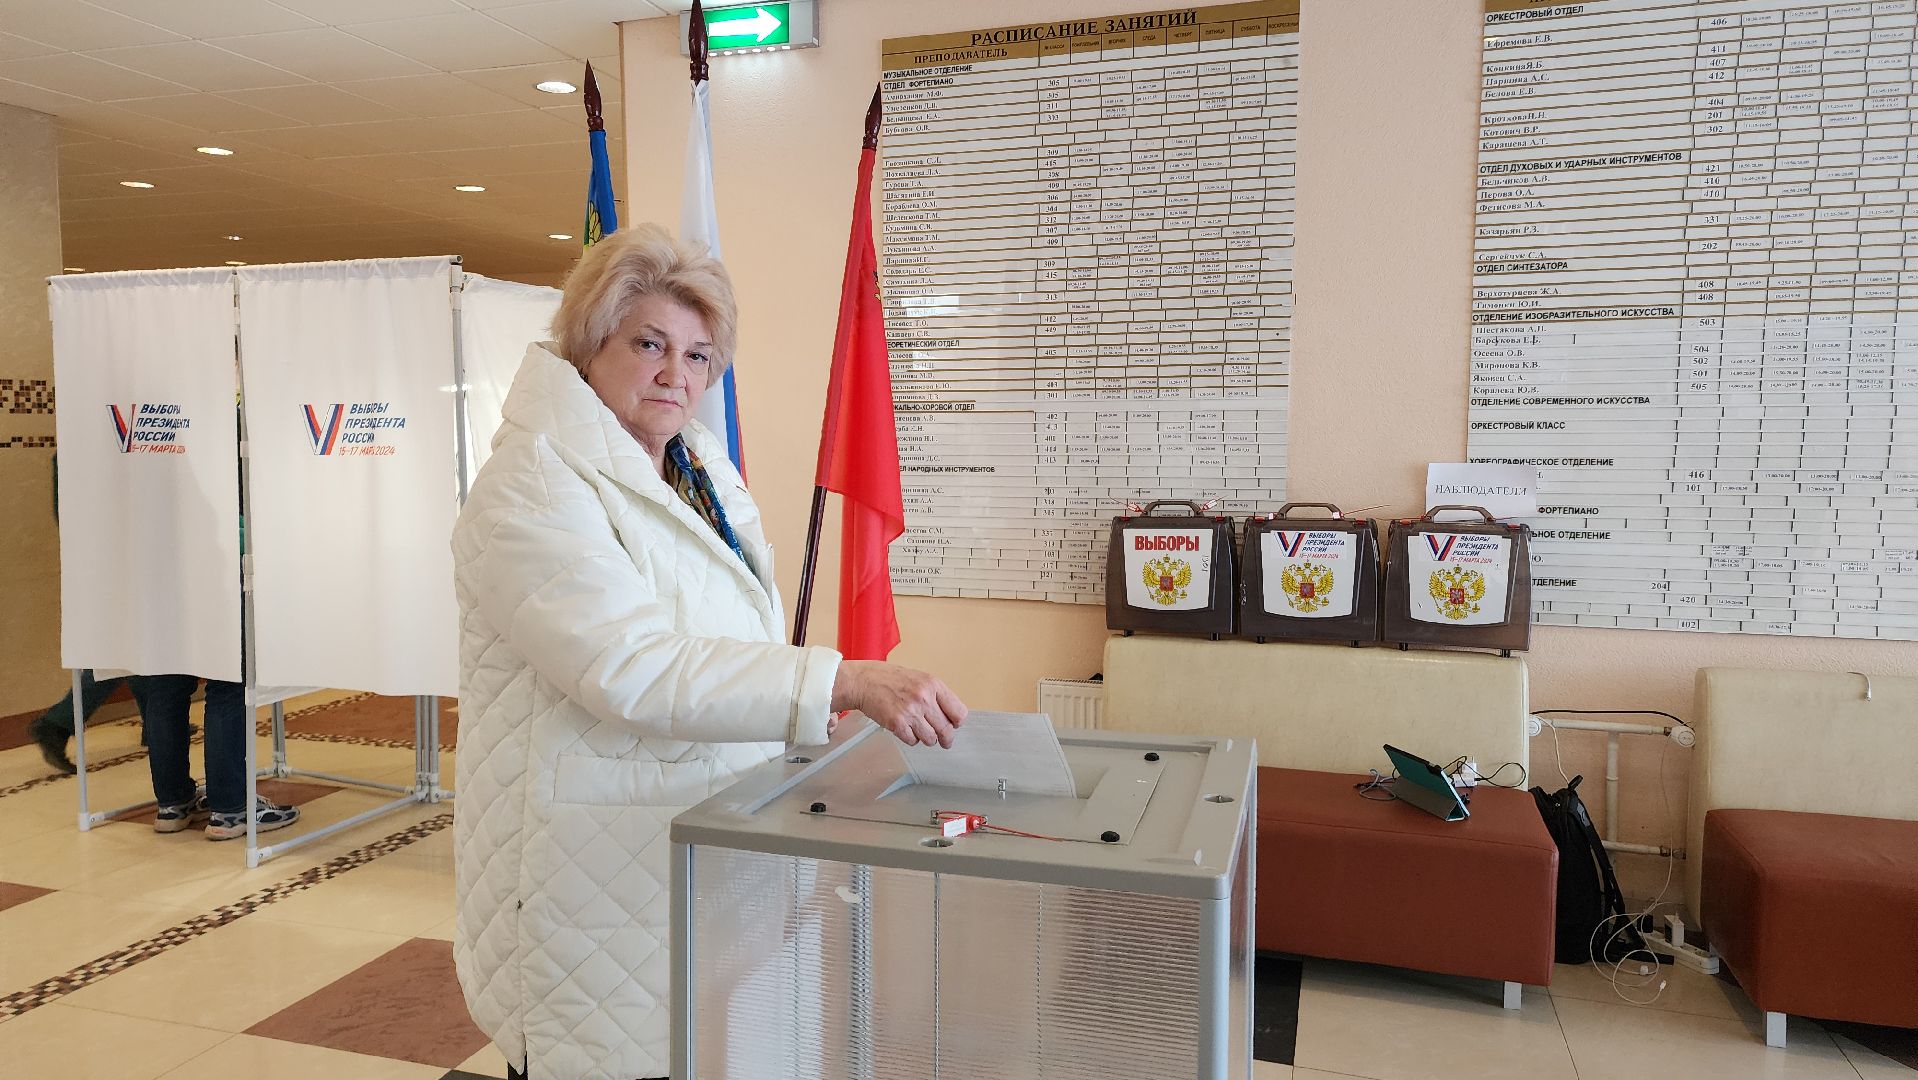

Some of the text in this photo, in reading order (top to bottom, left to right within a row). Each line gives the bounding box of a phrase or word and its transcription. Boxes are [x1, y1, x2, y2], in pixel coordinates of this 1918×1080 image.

[1486, 5, 1584, 22] ОРКЕСТРОВЫЙ ОТДЕЛ
[1710, 17, 1728, 26] 406
[971, 9, 1197, 46] РАСПИСАНИЕ ЗАНЯТИЙ
[914, 49, 1008, 64] ПРЕПОДАВАТЕЛЬ
[1709, 58, 1726, 67] 407
[883, 64, 973, 79] МУЗЫКАЛЬНОЕ ОТДЕЛЕНИЕ
[1708, 71, 1725, 80] 412
[883, 77, 954, 91] ОТДЕЛ ФОРТЕПИАНО
[1483, 128, 1521, 138] Котович
[1707, 125, 1723, 133] 302
[1480, 152, 1682, 174] ОТДЕЛ ДУХОВЫХ И УДАРНЫХ ИНСТРУМЕНТОВ
[1705, 164, 1720, 173] 421
[1702, 242, 1718, 250] 202
[1476, 261, 1568, 273] ОТДЕЛ СИНТЕЗАТОРА
[1698, 280, 1714, 289] 408
[1472, 307, 1674, 322] ОТДЕЛЕНИЕ ИЗОБРАЗИТЕЛЬНОГО ИСКУССТВА
[1699, 318, 1716, 327] 503
[887, 339, 960, 349] ЕОРЕТИЧЕСКИЙ ОТДЕЛ
[1693, 345, 1710, 354] 504
[1692, 357, 1709, 365] 502
[1692, 369, 1708, 378] 501
[1690, 383, 1707, 392] 505
[1471, 396, 1650, 406] ОТДЕЛЕНИЕ СОВРЕМЕННОГО ИСКУССТВА
[893, 403, 953, 411] КАЛЬНО-ХОРОВОЙ
[1471, 420, 1566, 430] ОРКЕСТРОВЫЙ КЛАСС
[133, 431, 176, 442] РОССИИ
[148, 444, 175, 453] МАРТА
[375, 445, 396, 456] 2024
[1470, 458, 1614, 466] ХОРЕОГРАФИЧЕСКОЕ ОТДЕЛЕНИЕ
[1688, 471, 1705, 479] 416
[1434, 484, 1527, 496] НАБЛЮДАТЕЛИ
[1686, 484, 1701, 492] 101
[1538, 506, 1599, 515] ФОРТЕПИАНО
[1460, 535, 1491, 543] ВЫБОРЫ
[1558, 531, 1611, 540] ОТДЕЛЕНИЕ
[1134, 535, 1200, 552] ВЫБОРЫ
[1304, 539, 1345, 547] ПРЕЗИДЕНТА
[1456, 542, 1499, 551] ПРЕЗИДЕНТА
[1532, 578, 1577, 587] ТДЕЛЕНИЕ
[1651, 582, 1667, 590] 204
[1680, 596, 1696, 604] 420
